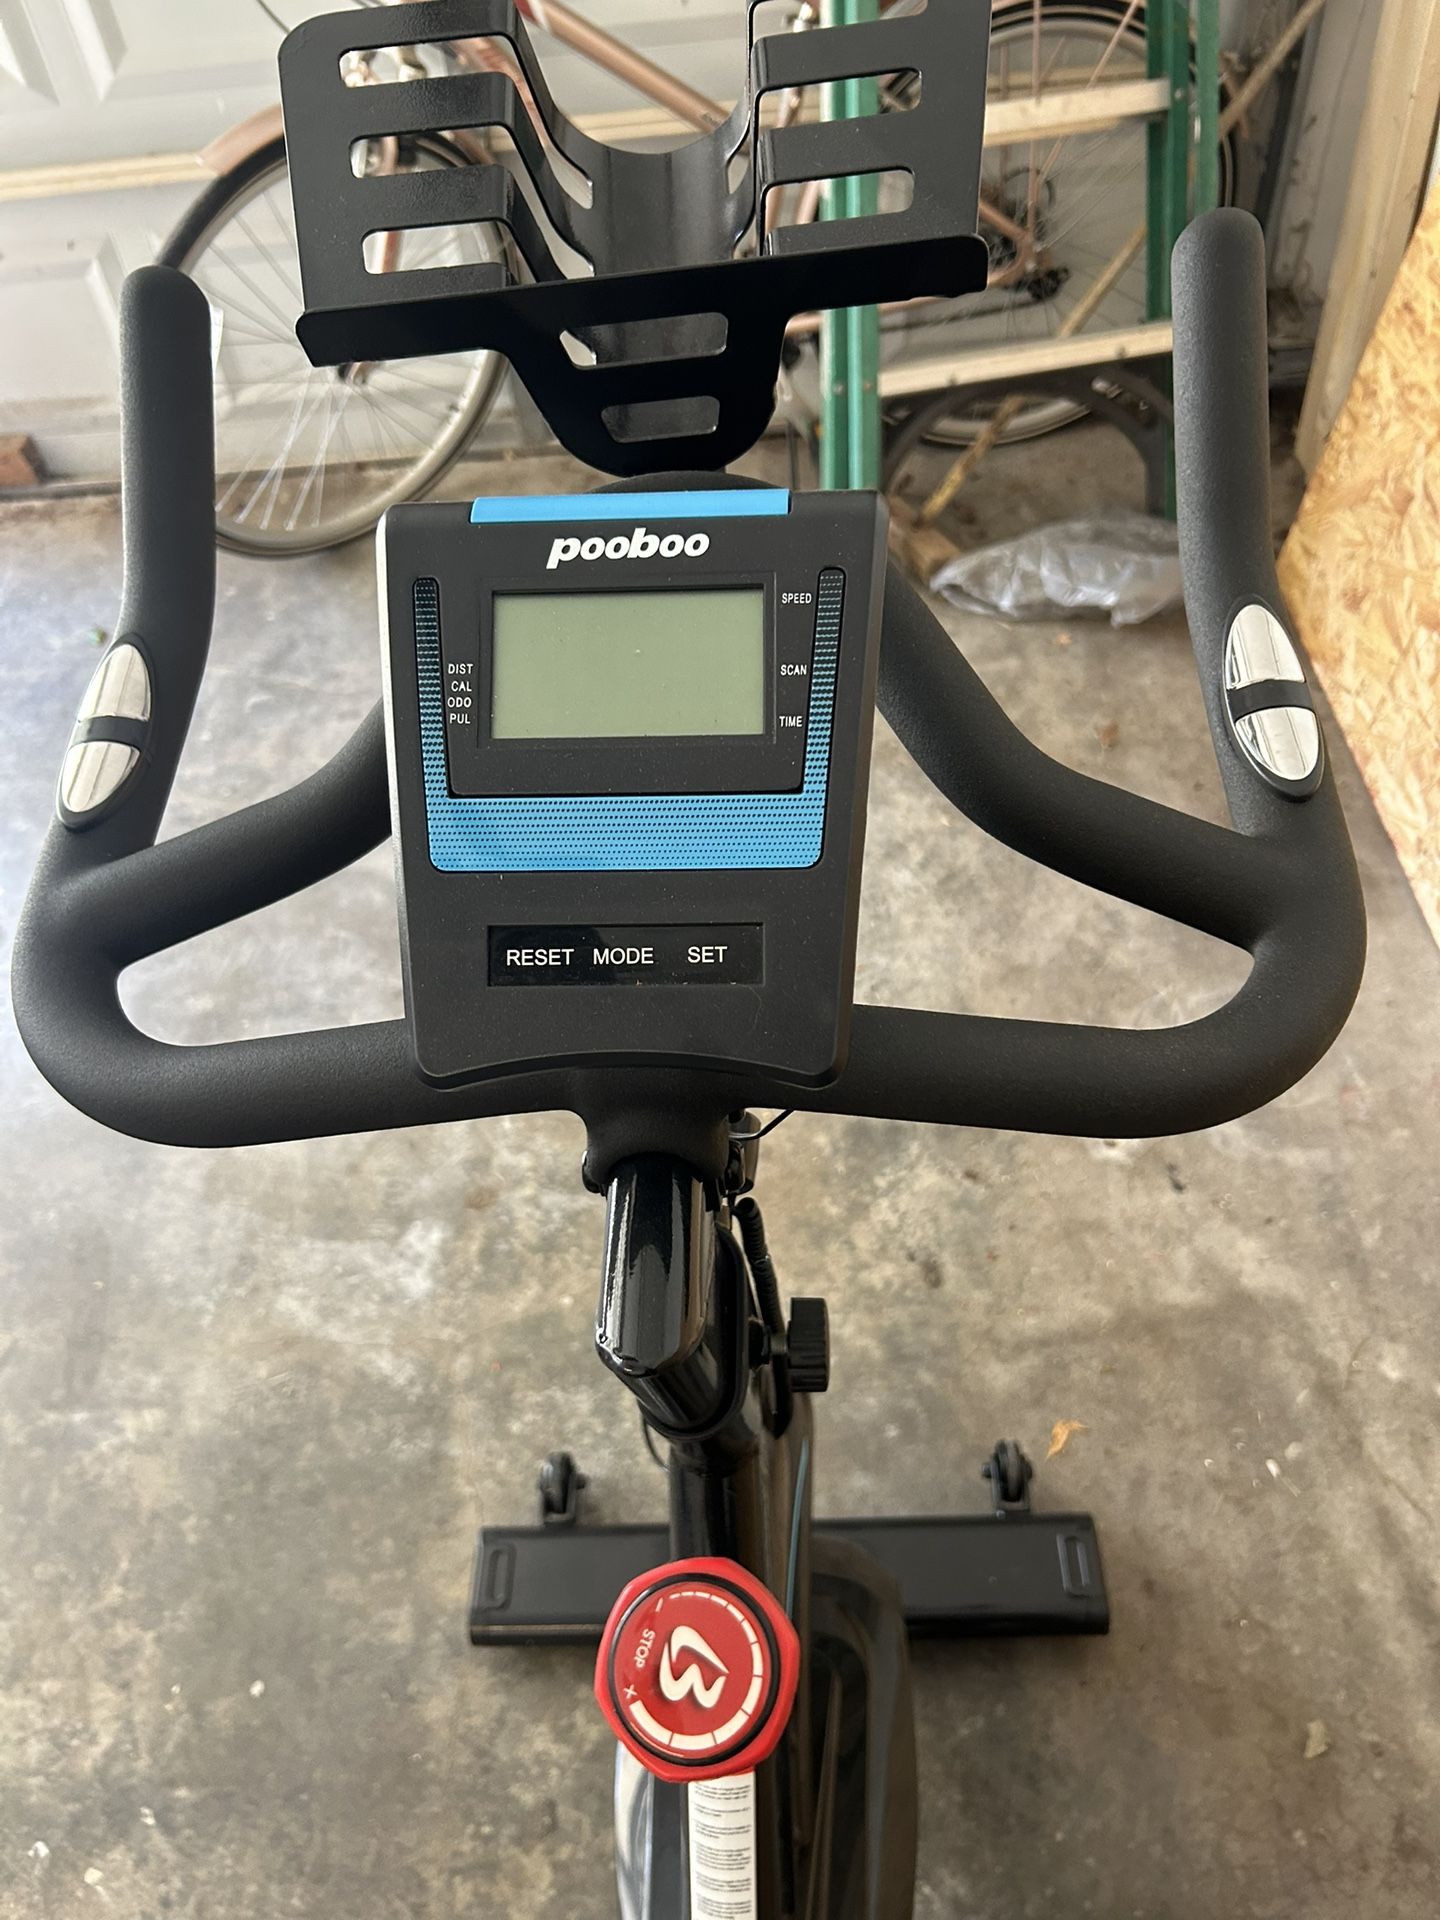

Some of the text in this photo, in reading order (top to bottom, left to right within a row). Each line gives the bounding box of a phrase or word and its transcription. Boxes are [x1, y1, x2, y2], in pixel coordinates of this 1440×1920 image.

[546, 528, 710, 569] pooboo
[781, 592, 812, 605] SPEED
[447, 663, 474, 675] DIST
[780, 664, 808, 676] SCAN
[450, 680, 473, 692] CAL
[447, 696, 472, 708] ODO
[449, 713, 471, 724] PUL
[779, 716, 803, 728] TIME
[506, 945, 728, 966] RESET MODE SET
[634, 1628, 656, 1669] STOP
